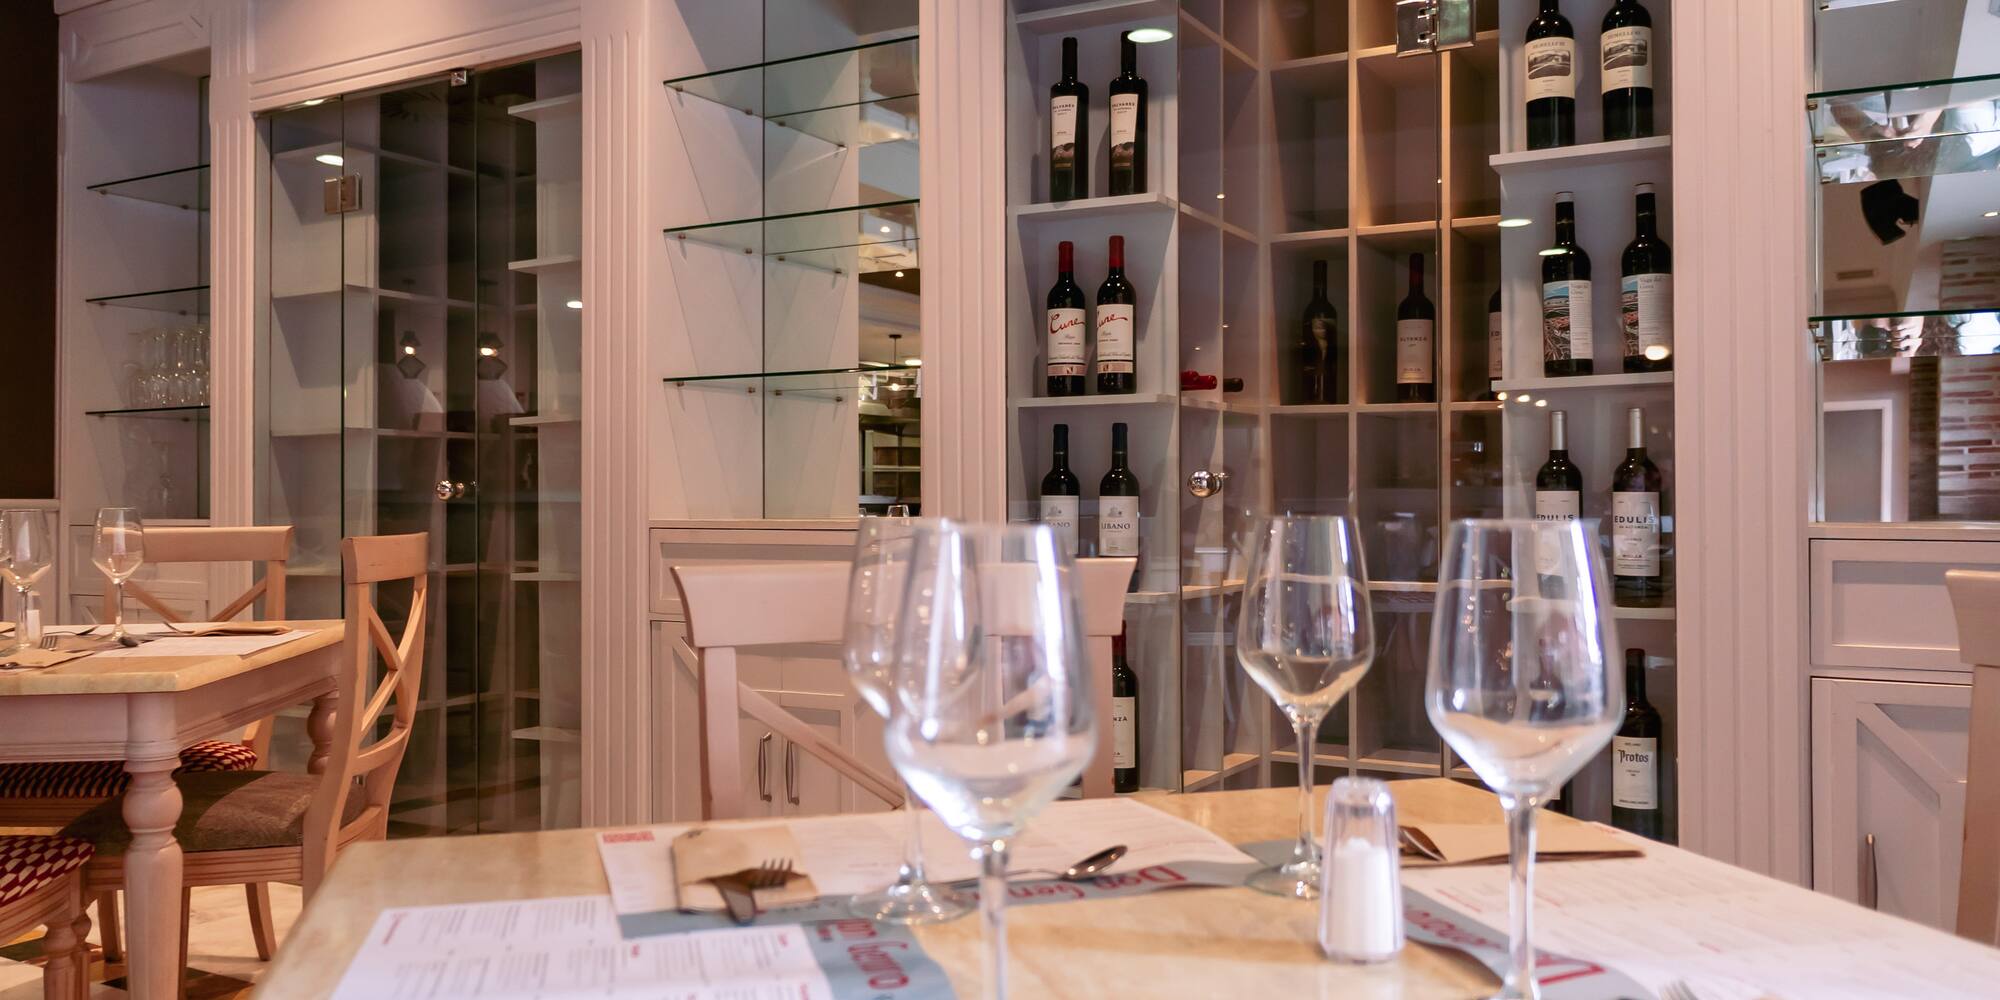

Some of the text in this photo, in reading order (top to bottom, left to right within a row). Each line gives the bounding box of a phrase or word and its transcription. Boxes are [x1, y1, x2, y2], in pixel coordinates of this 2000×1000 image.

[1050, 313, 1085, 334] Cune
[1097, 310, 1128, 330] une
[1615, 515, 1656, 524] EDULIS
[1617, 749, 1649, 763] Protos
